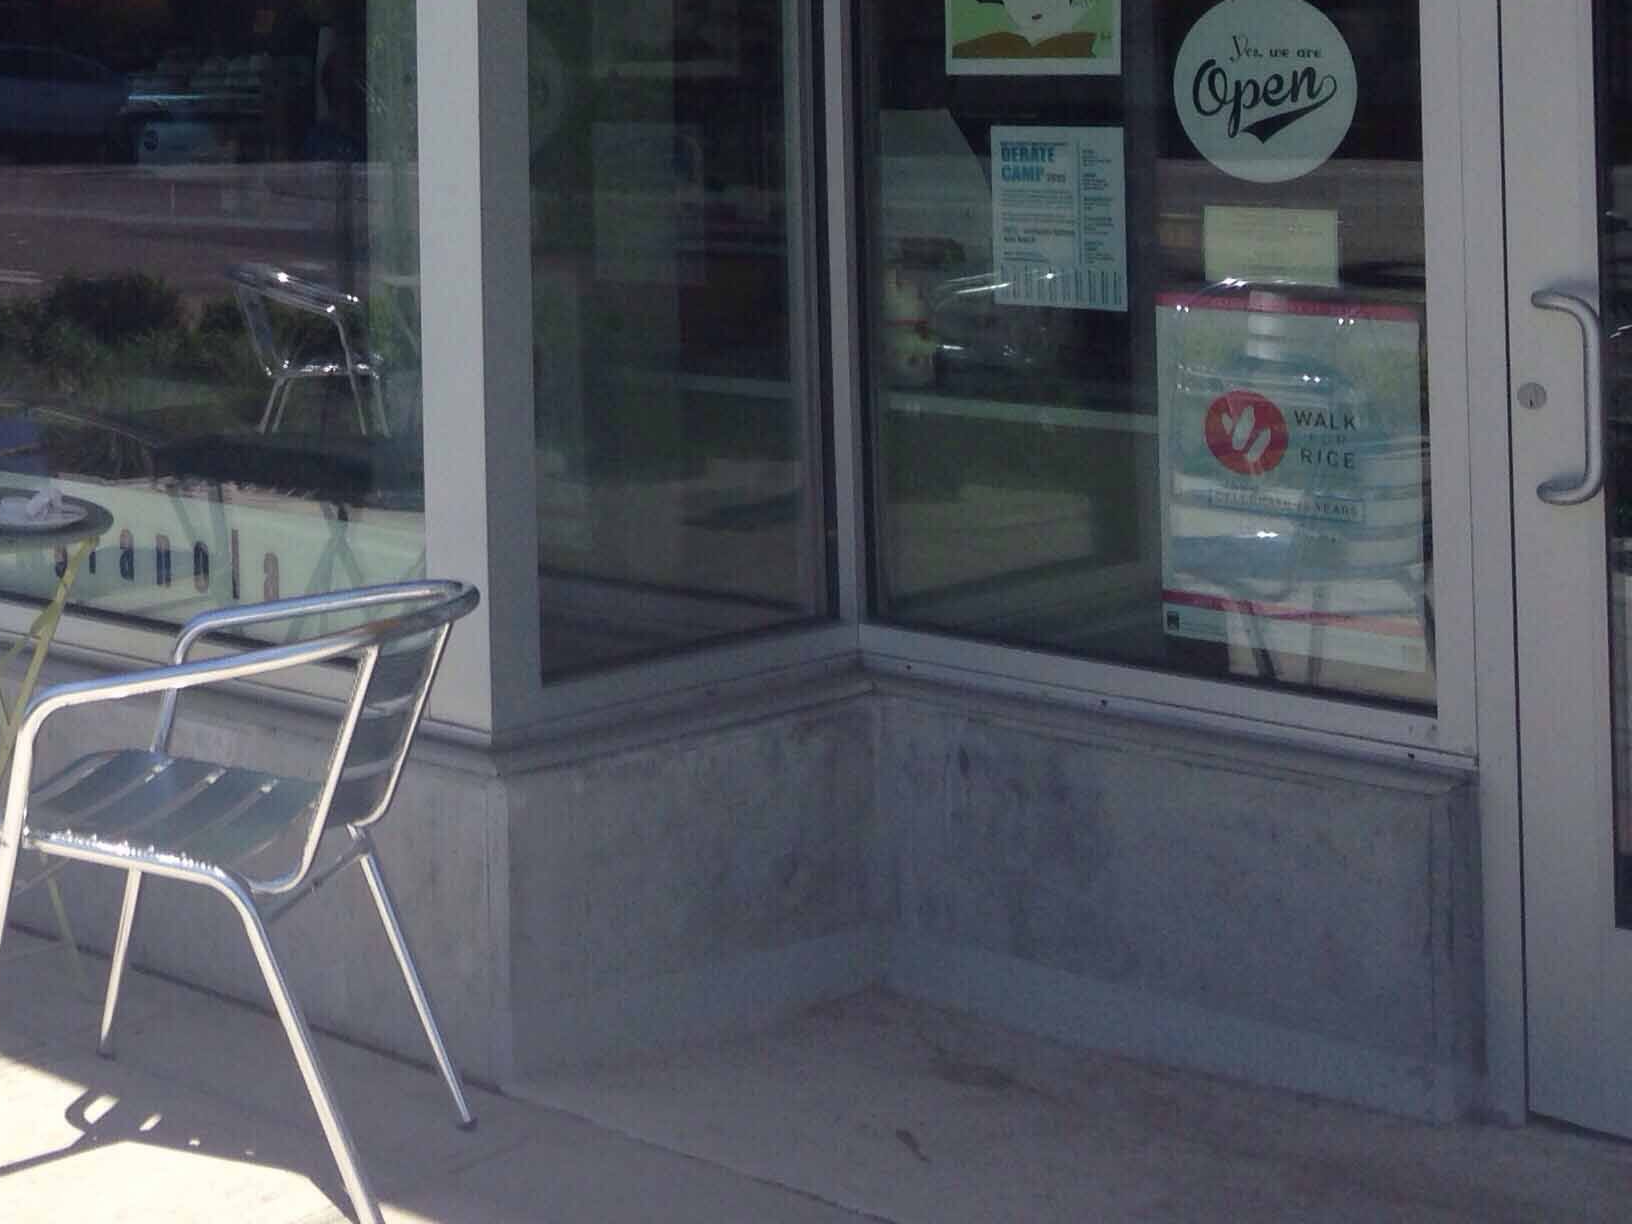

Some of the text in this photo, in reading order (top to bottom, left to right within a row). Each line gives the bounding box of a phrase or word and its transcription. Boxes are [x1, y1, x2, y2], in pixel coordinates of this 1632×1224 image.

[1269, 47, 1291, 59] we
[1296, 47, 1322, 59] are
[1193, 59, 1336, 139] Open
[1294, 409, 1357, 432] WALK
[1299, 447, 1356, 471] RICE
